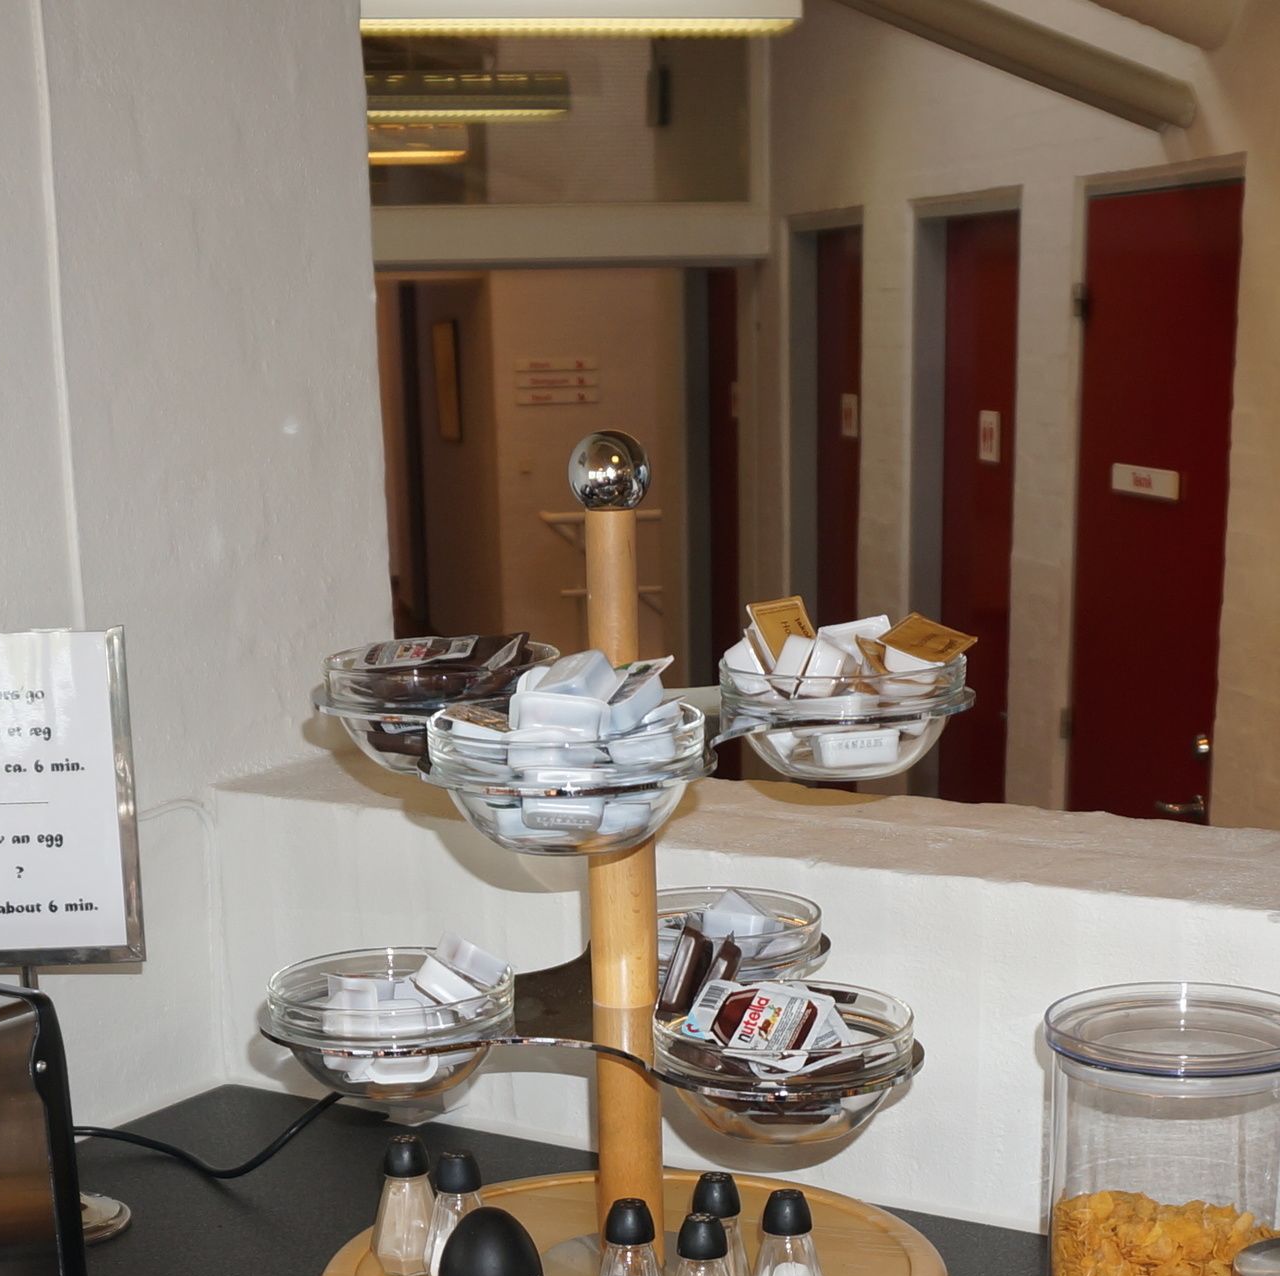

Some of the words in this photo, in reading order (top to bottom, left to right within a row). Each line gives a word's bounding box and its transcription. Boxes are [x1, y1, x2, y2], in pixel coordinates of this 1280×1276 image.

[29, 726, 52, 741] æg
[4, 762, 27, 774] ca.
[33, 759, 44, 774] 6
[51, 758, 85, 772] min.
[11, 833, 31, 845] an
[36, 833, 64, 847] egg
[15, 866, 24, 878] ?
[49, 900, 59, 914] 6
[64, 899, 99, 913] min.
[737, 997, 771, 1043] nutella
